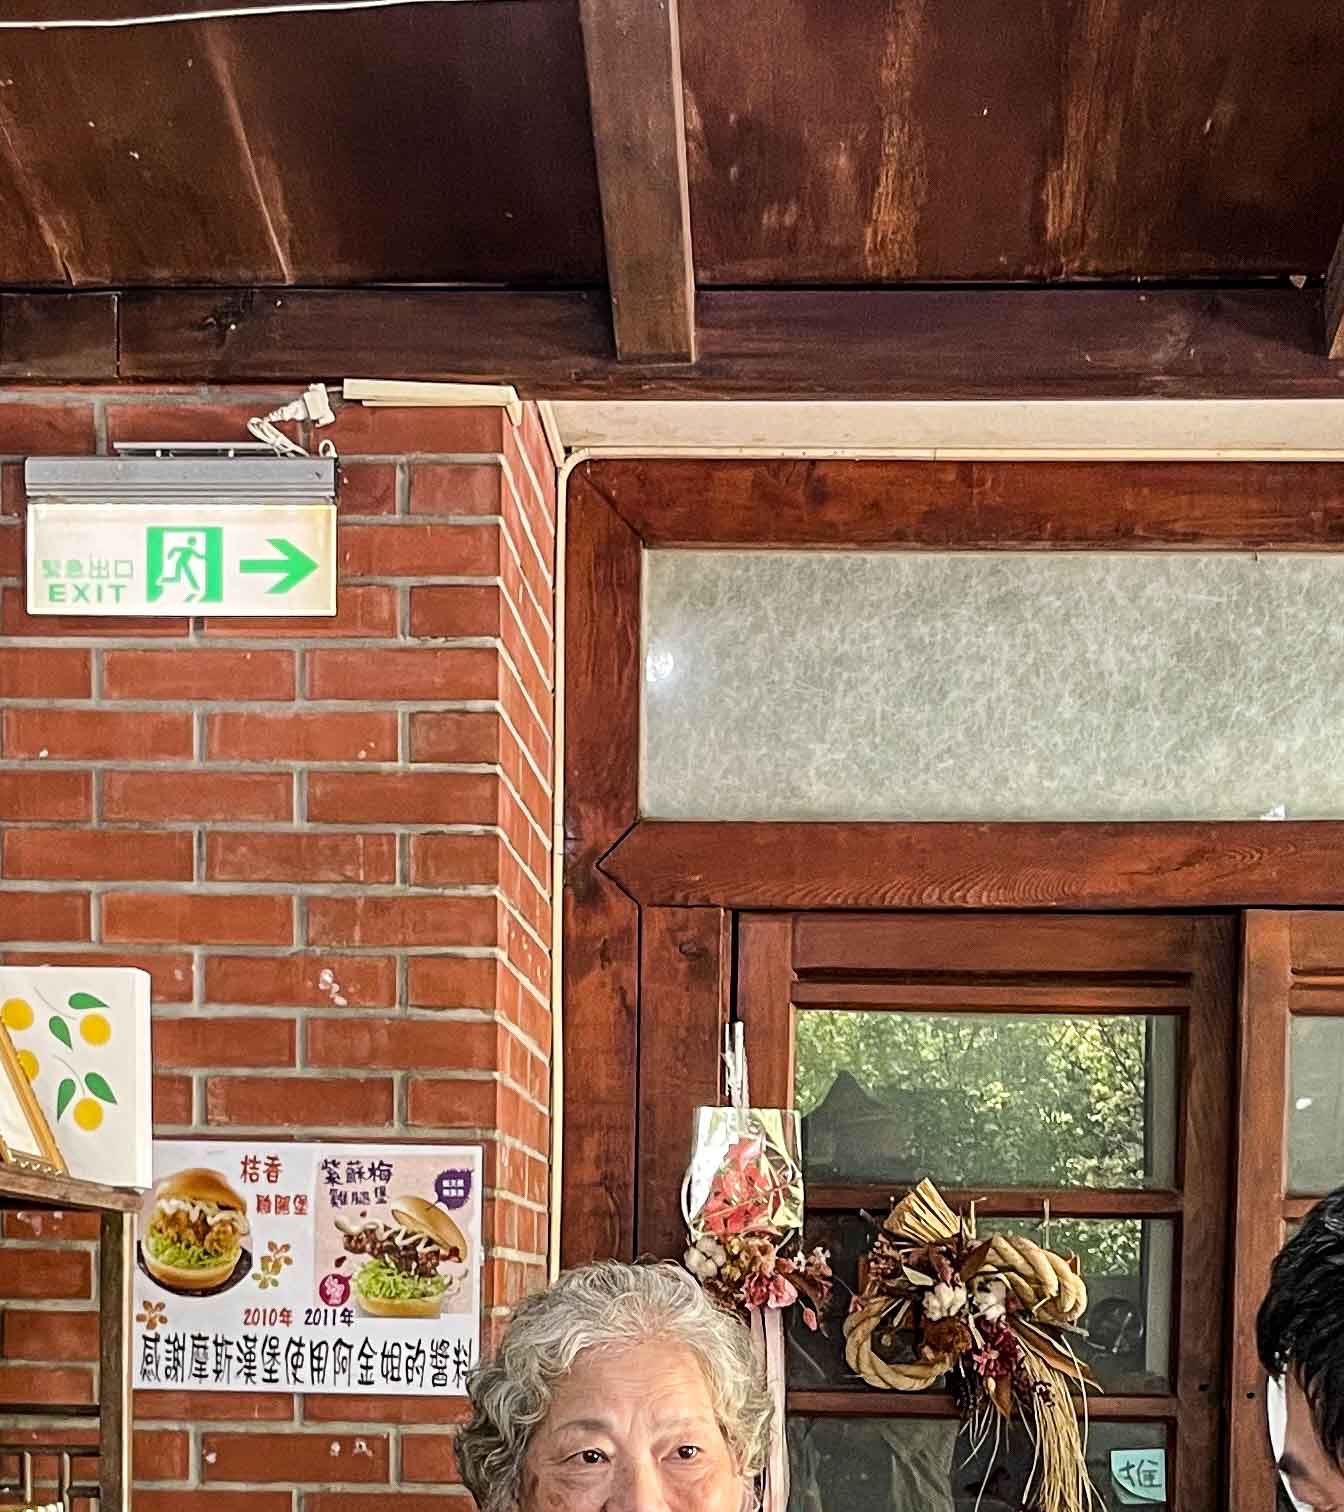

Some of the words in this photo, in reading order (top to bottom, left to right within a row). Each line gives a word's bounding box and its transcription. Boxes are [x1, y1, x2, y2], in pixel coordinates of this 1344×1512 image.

[48, 584, 127, 603] EXIT
[243, 1307, 294, 1328] 2010年
[303, 1307, 355, 1328] 2011年
